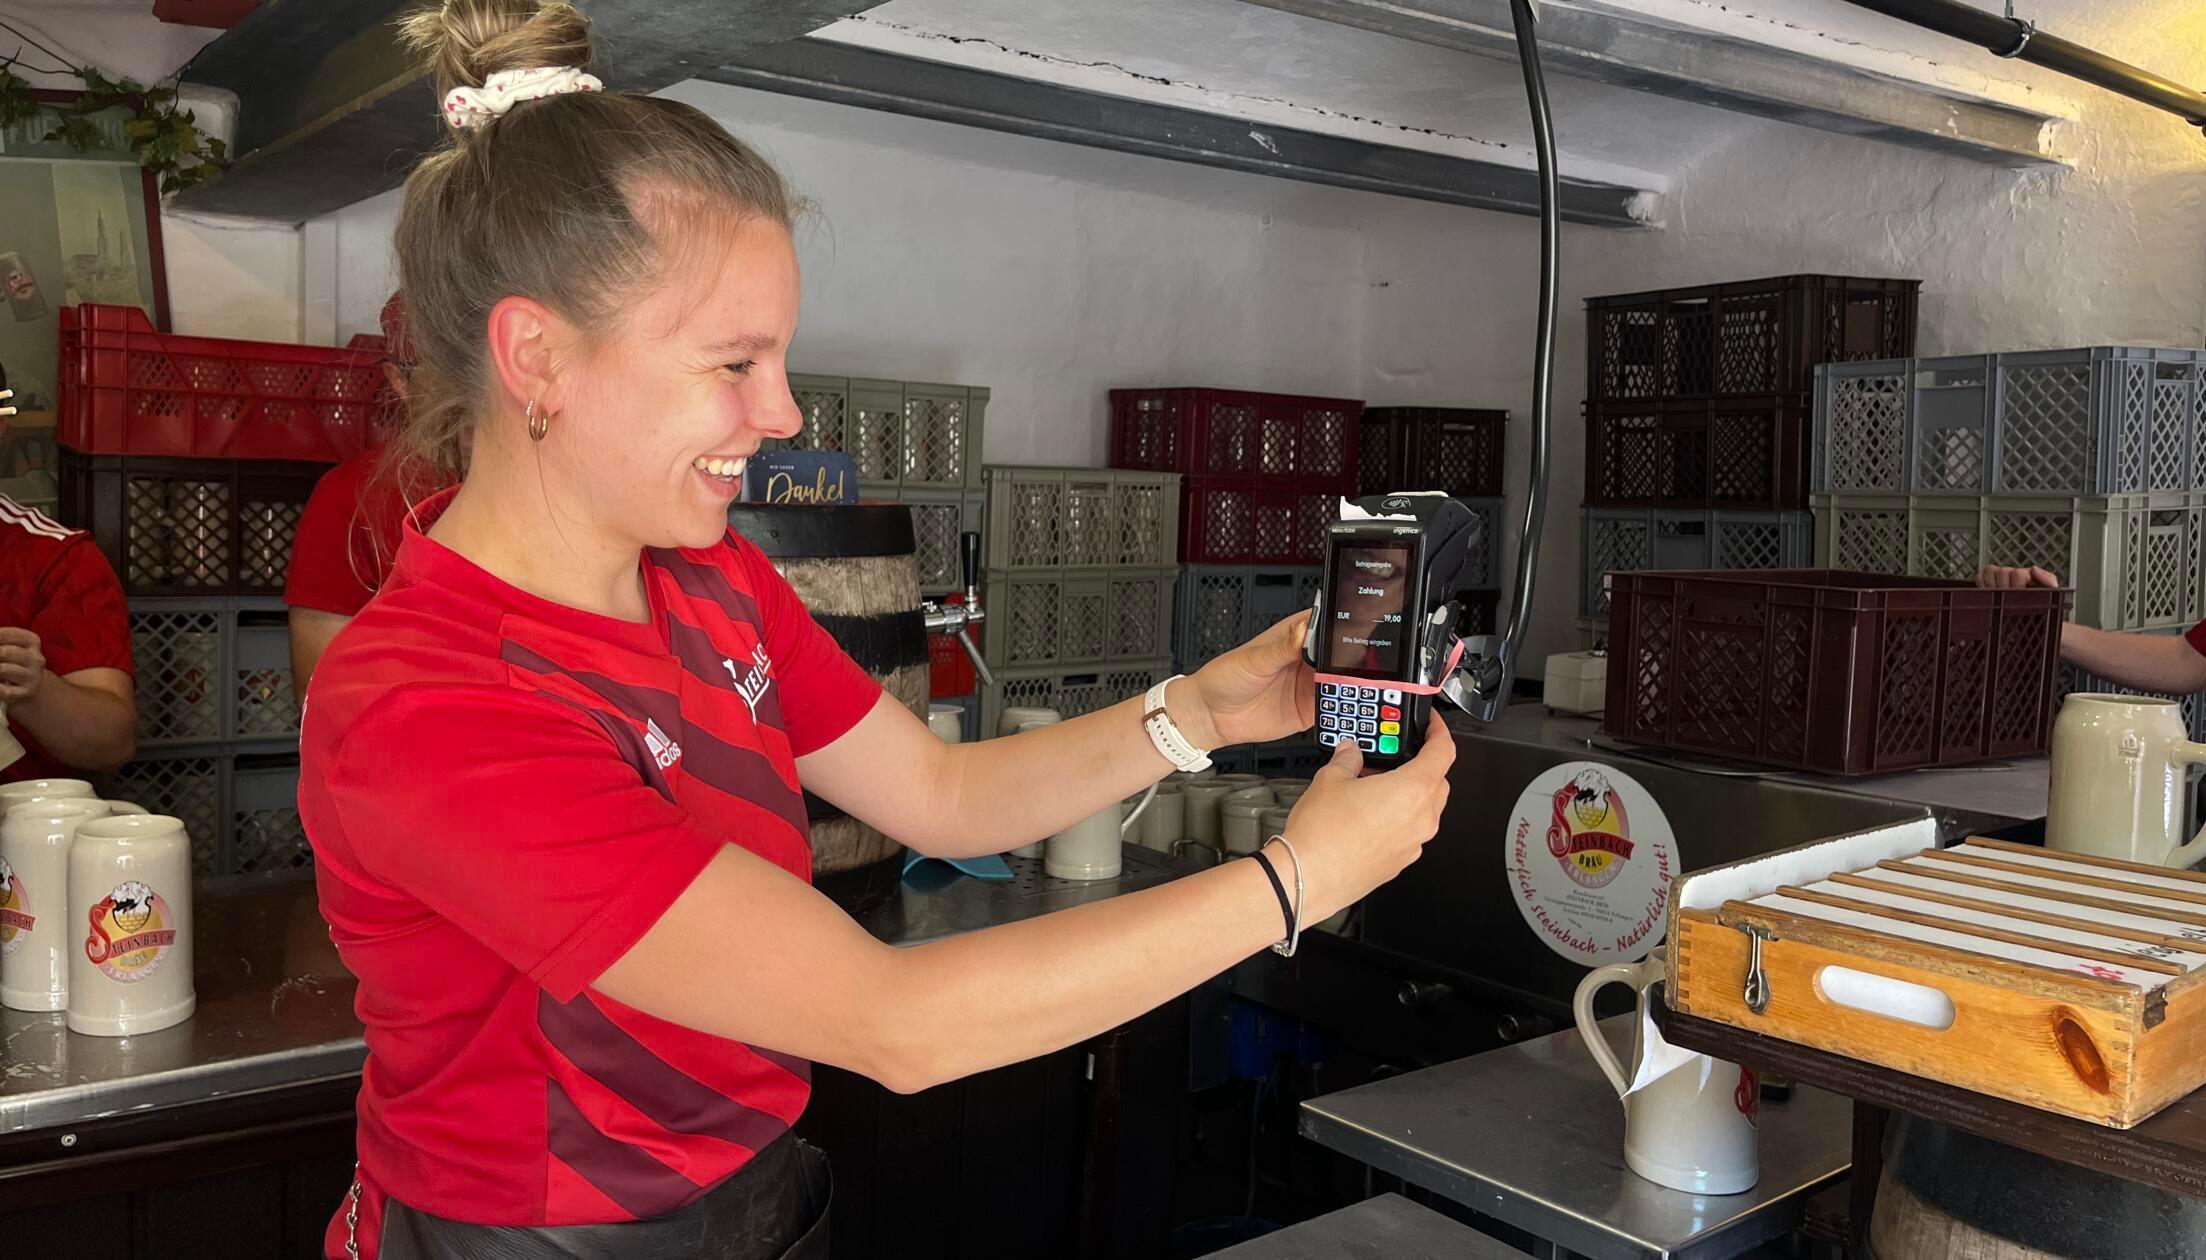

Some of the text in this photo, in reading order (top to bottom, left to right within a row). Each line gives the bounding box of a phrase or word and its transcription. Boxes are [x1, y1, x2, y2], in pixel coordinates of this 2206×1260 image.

[766, 466, 844, 504] Danke!
[1393, 527, 1419, 536] ingenico
[1358, 586, 1384, 597] Zahlung
[1337, 611, 1350, 620] EUR
[1546, 788, 1631, 860] STEINBACH
[1514, 817, 1537, 901] Natürlich
[1616, 886, 1668, 952] Natürlich
[1653, 843, 1676, 883] gut!
[85, 902, 174, 965] STEINBACH
